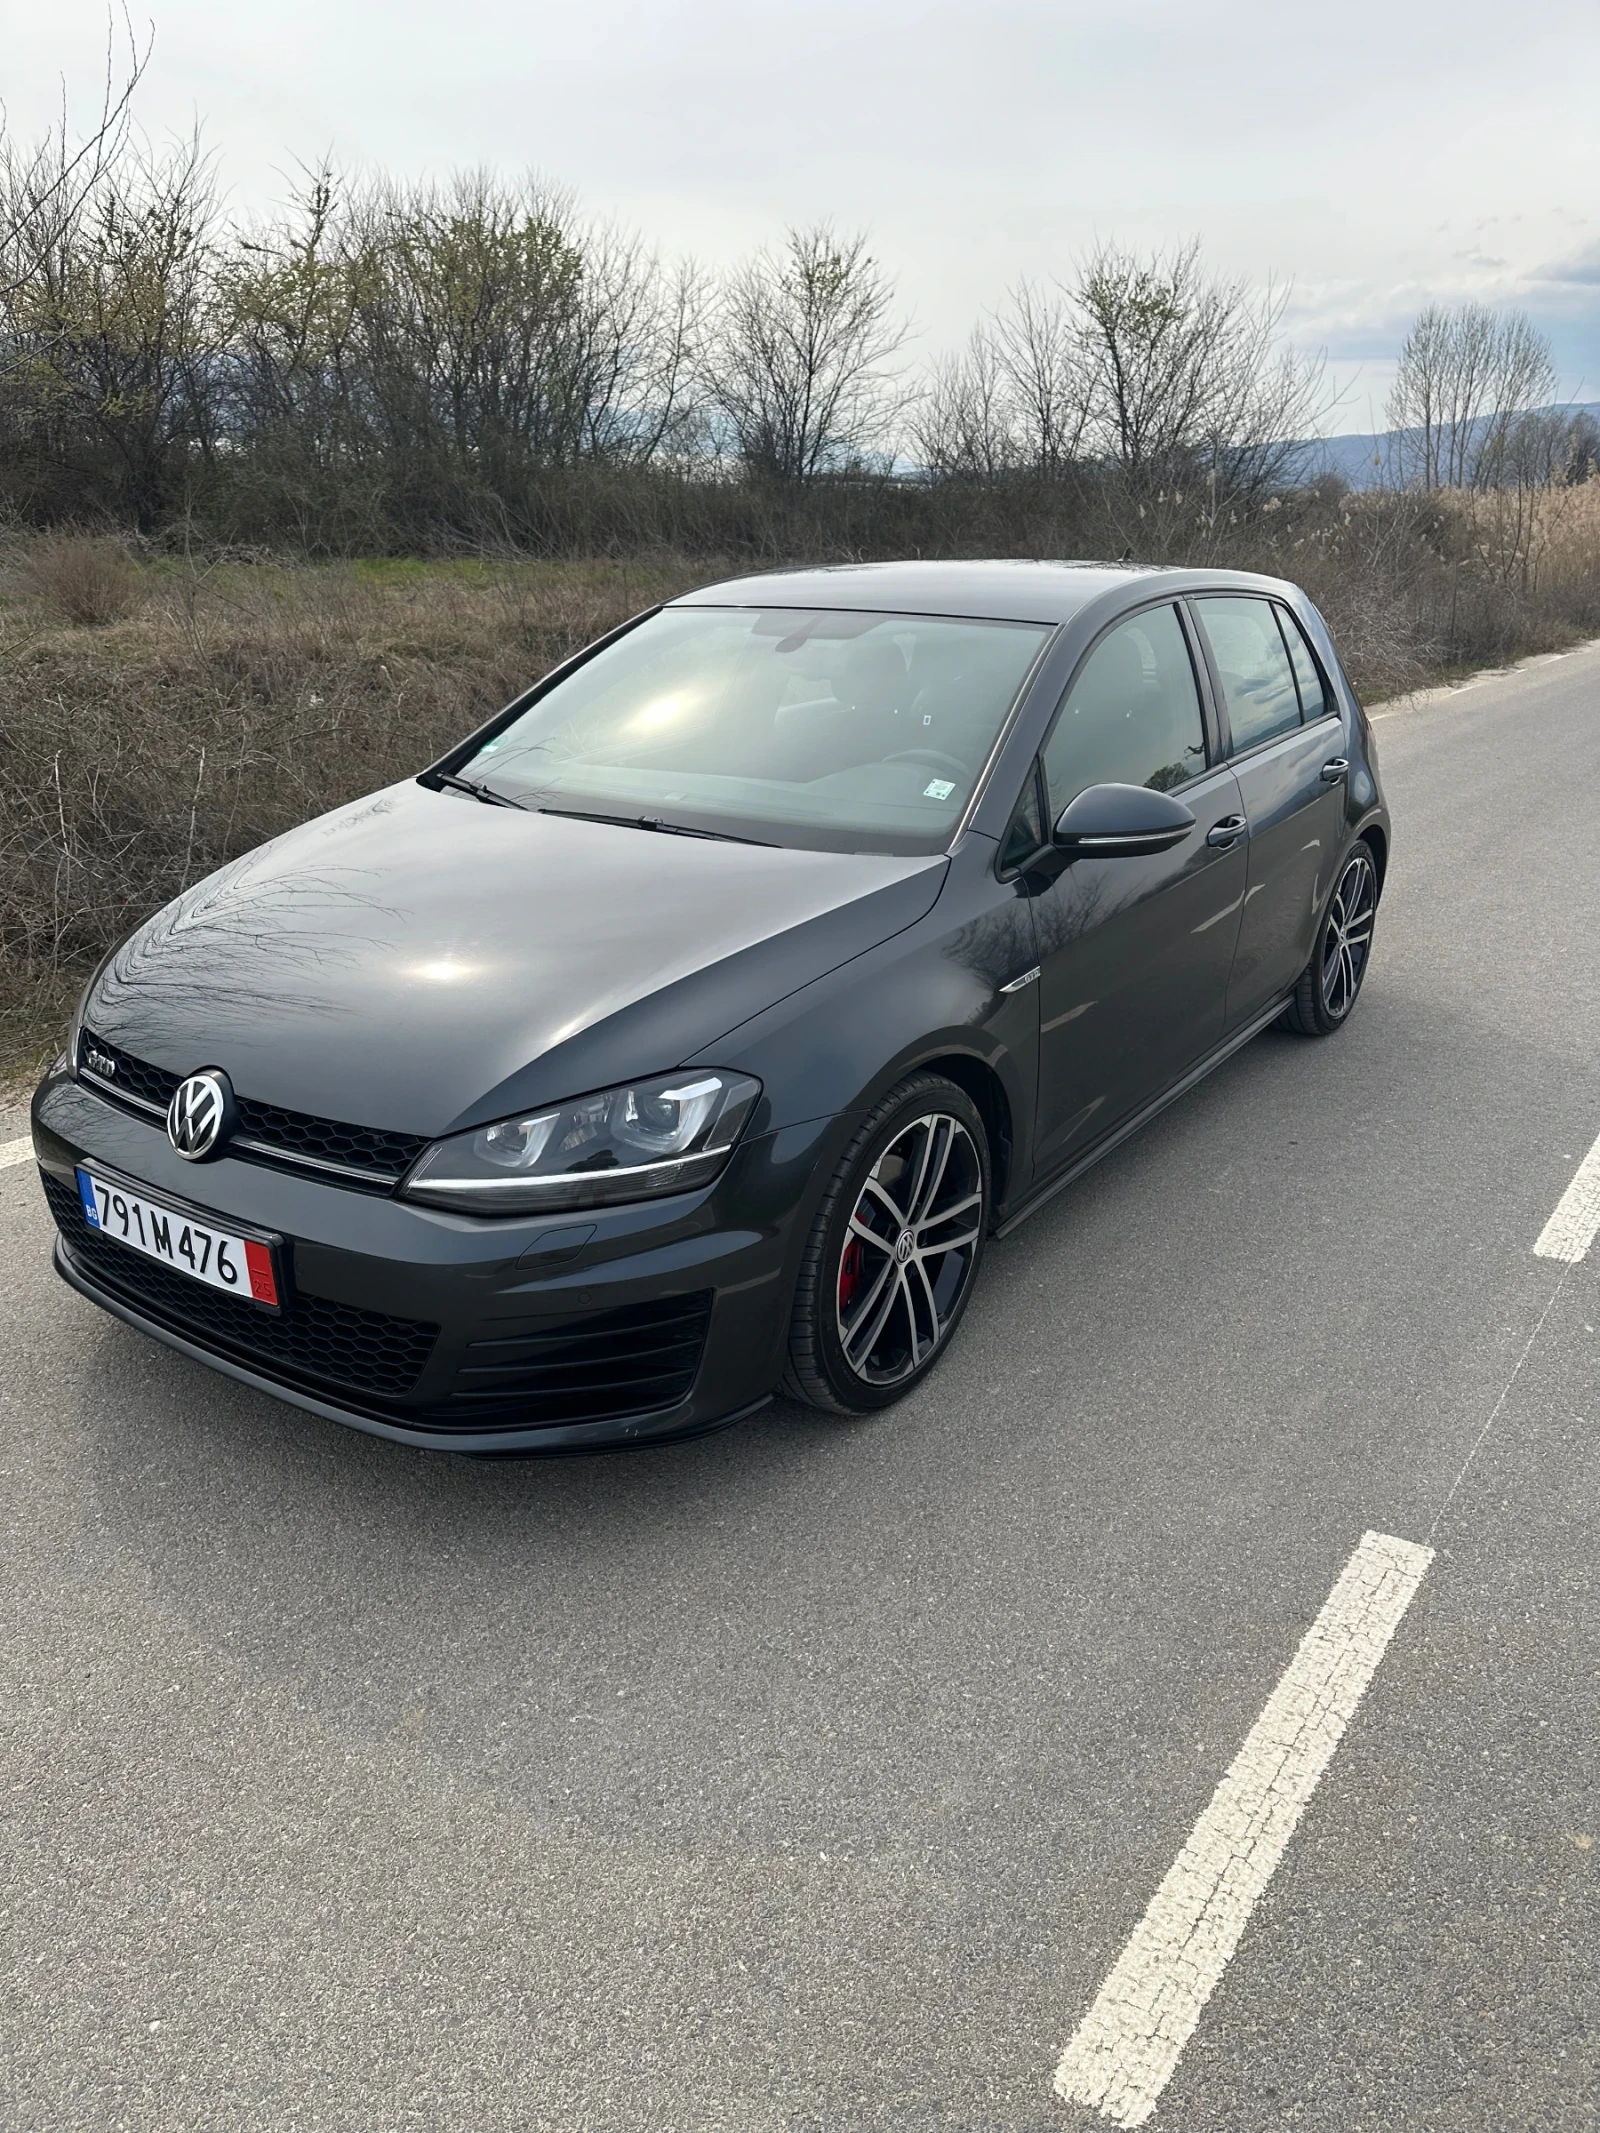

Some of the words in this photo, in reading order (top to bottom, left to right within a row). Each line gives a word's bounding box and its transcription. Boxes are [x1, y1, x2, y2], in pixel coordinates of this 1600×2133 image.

[86, 1204, 98, 1220] BG
[95, 1184, 238, 1285] 791M476
[254, 1280, 272, 1297] 25
